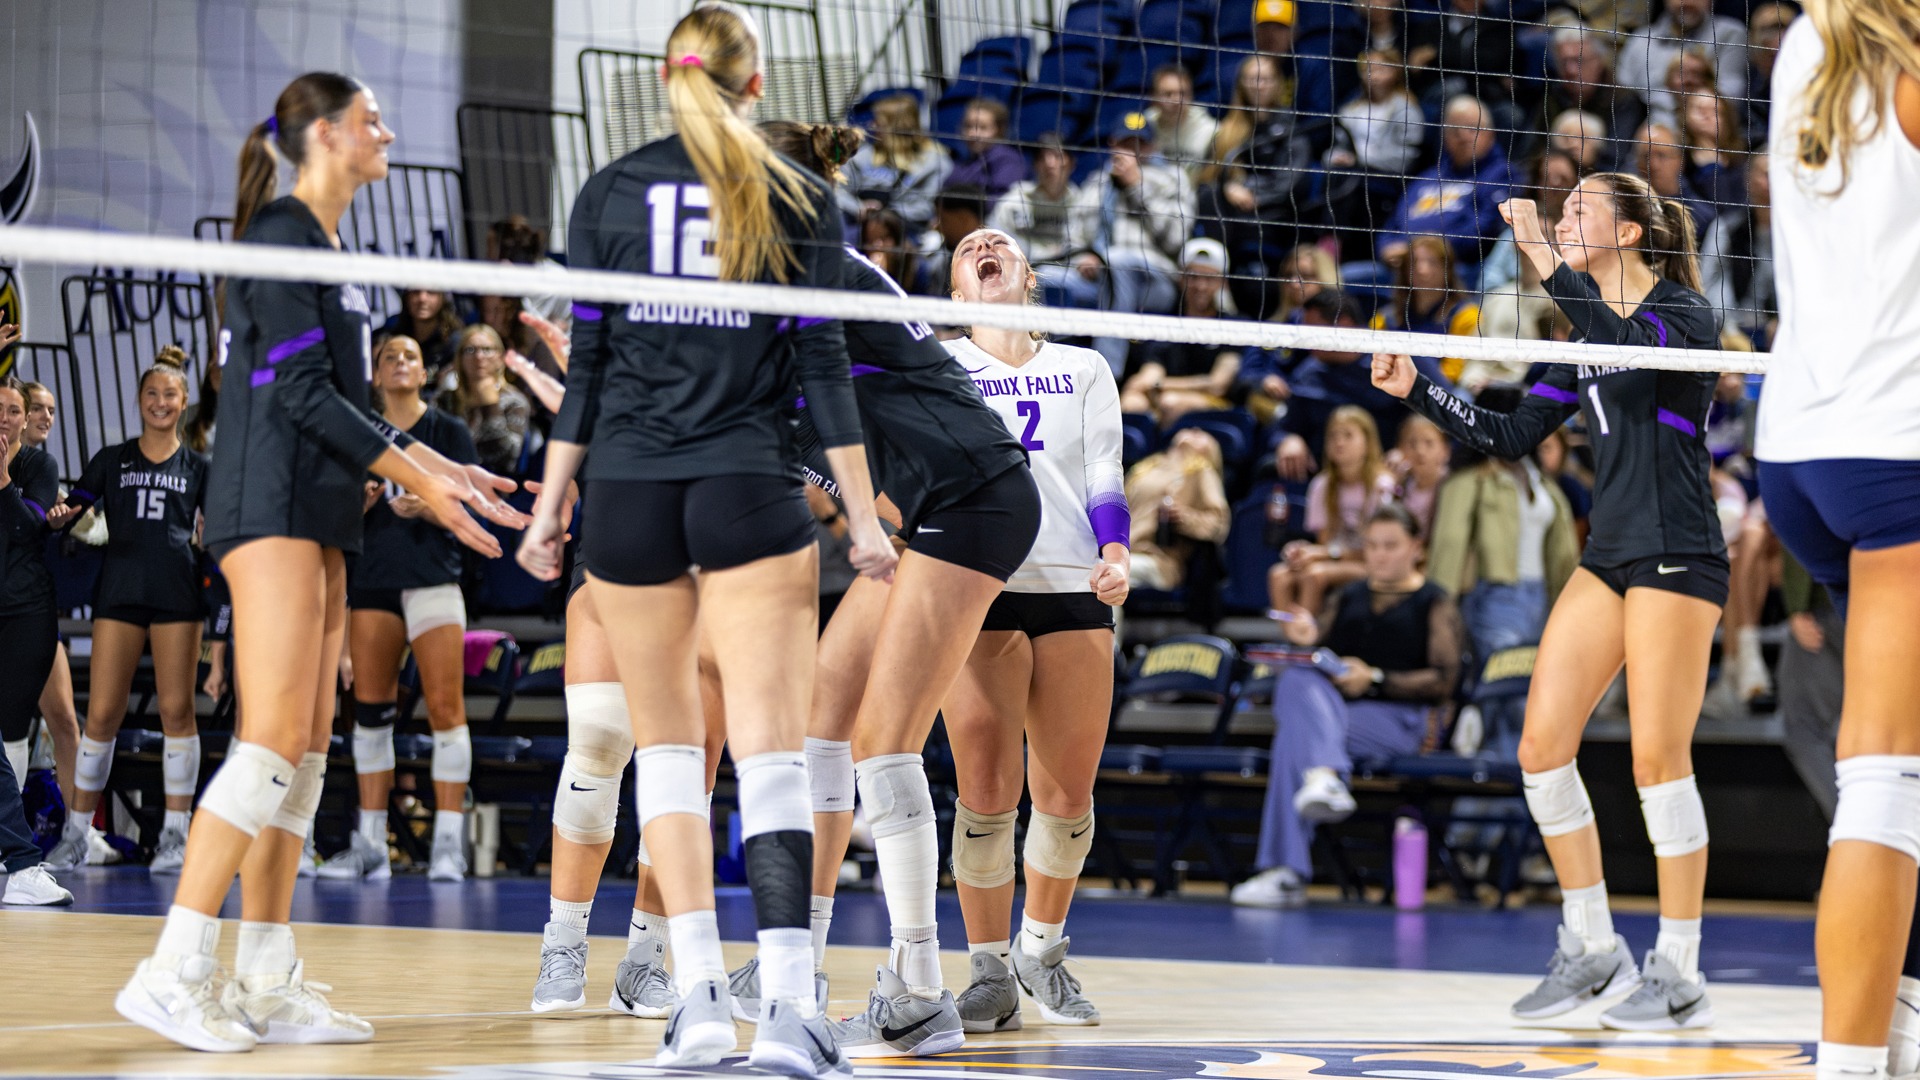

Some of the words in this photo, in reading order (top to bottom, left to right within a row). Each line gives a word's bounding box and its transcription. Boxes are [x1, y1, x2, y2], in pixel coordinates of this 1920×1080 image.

[646, 183, 722, 278] 12
[974, 376, 1021, 397] SIOUX
[1025, 374, 1073, 395] FALLS
[1017, 401, 1045, 451] 2
[1588, 383, 1610, 435] 1
[120, 471, 152, 489] SIOUX
[154, 473, 187, 494] FALLS
[136, 488, 167, 520] 15
